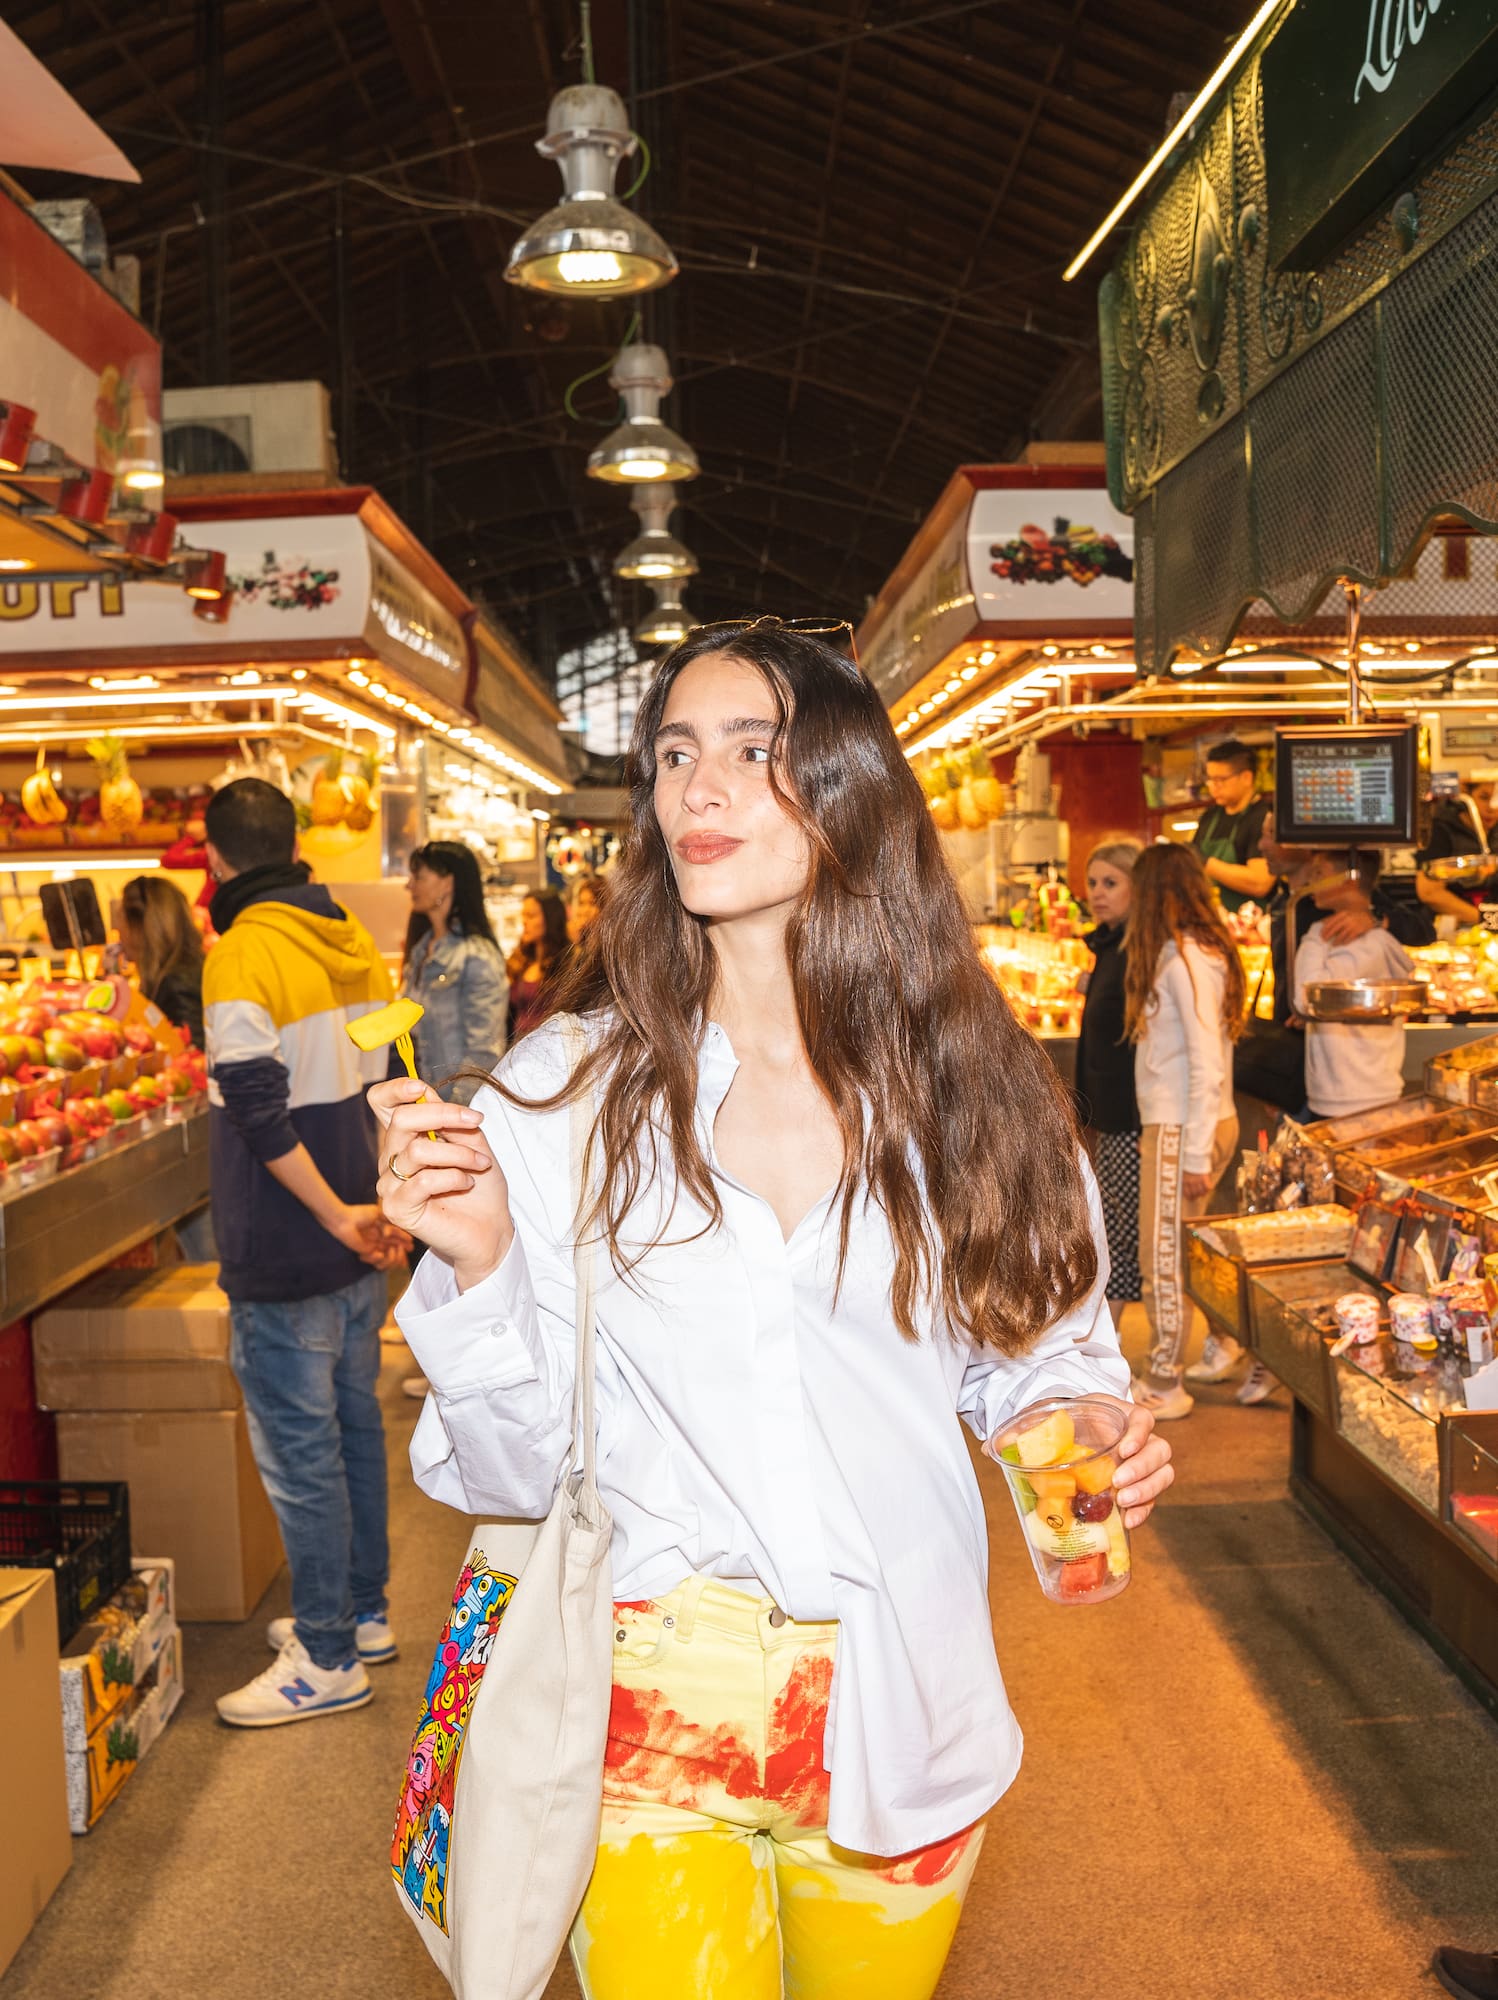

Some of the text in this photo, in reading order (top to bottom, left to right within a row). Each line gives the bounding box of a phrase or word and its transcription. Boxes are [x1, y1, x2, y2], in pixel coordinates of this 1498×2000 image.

[1162, 1134, 1180, 1156] ICE
[1160, 1160, 1178, 1195] PLAY
[1159, 1197, 1176, 1217] ICE
[1159, 1221, 1175, 1253] PLAY
[1159, 1254, 1175, 1275] ICE
[1159, 1280, 1177, 1310] PLAY
[279, 1677, 316, 1707] N
